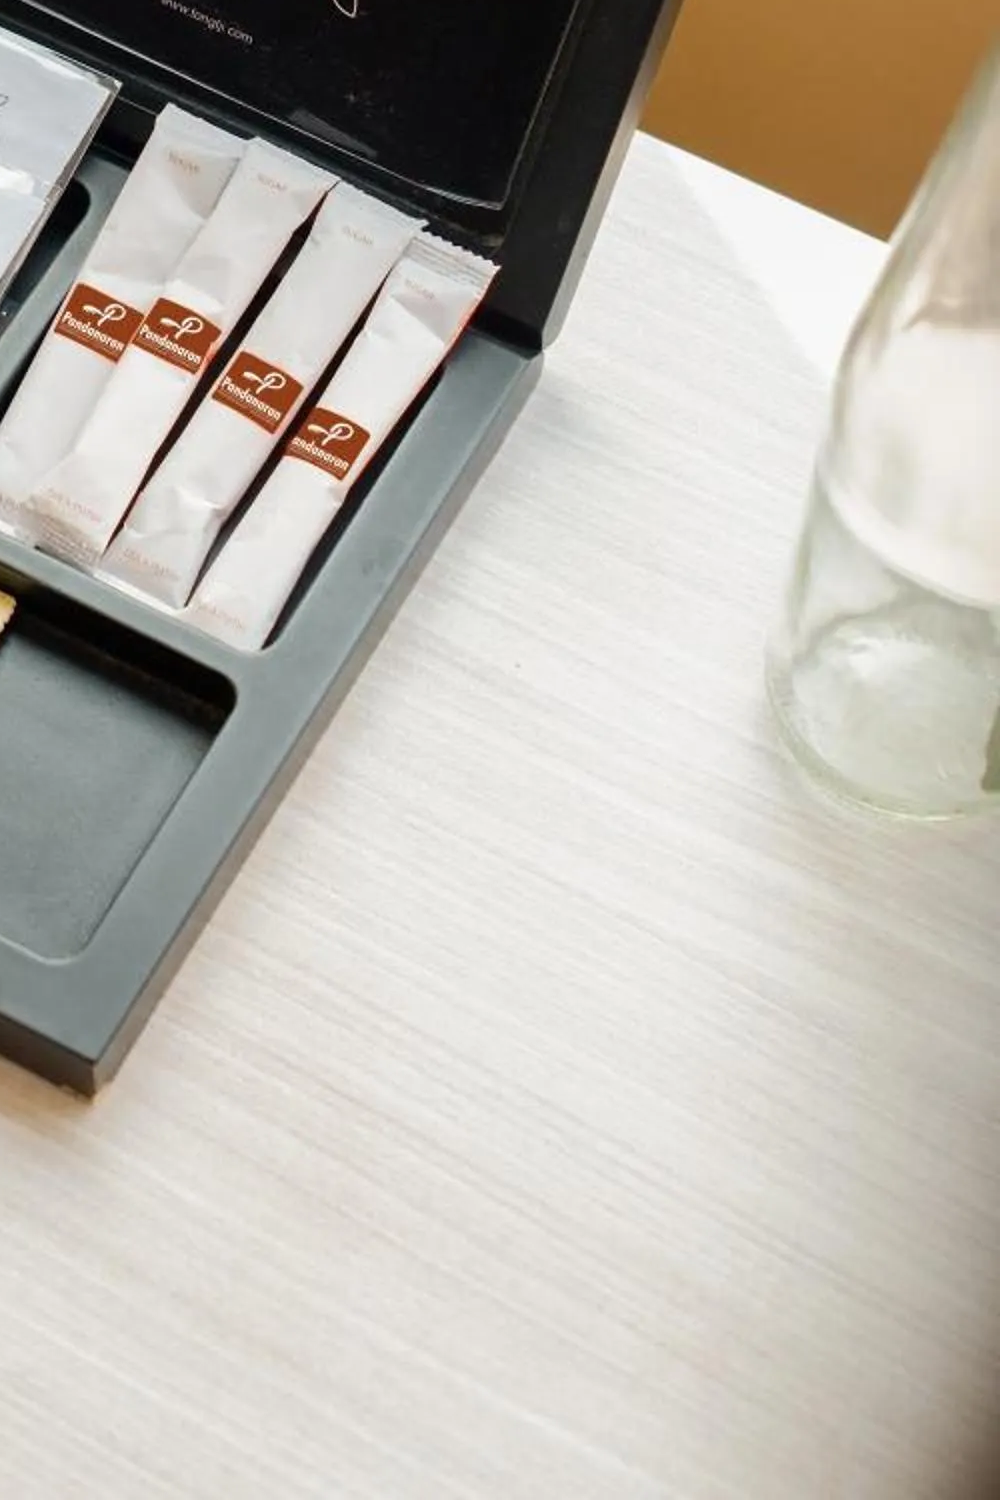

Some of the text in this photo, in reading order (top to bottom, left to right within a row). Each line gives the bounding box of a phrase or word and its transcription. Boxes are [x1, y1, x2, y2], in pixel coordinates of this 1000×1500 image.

[61, 310, 125, 352] Pandanaran
[139, 323, 202, 365] Pandanaran
[220, 376, 283, 423] Pandanaran
[291, 436, 350, 472] andanaran
